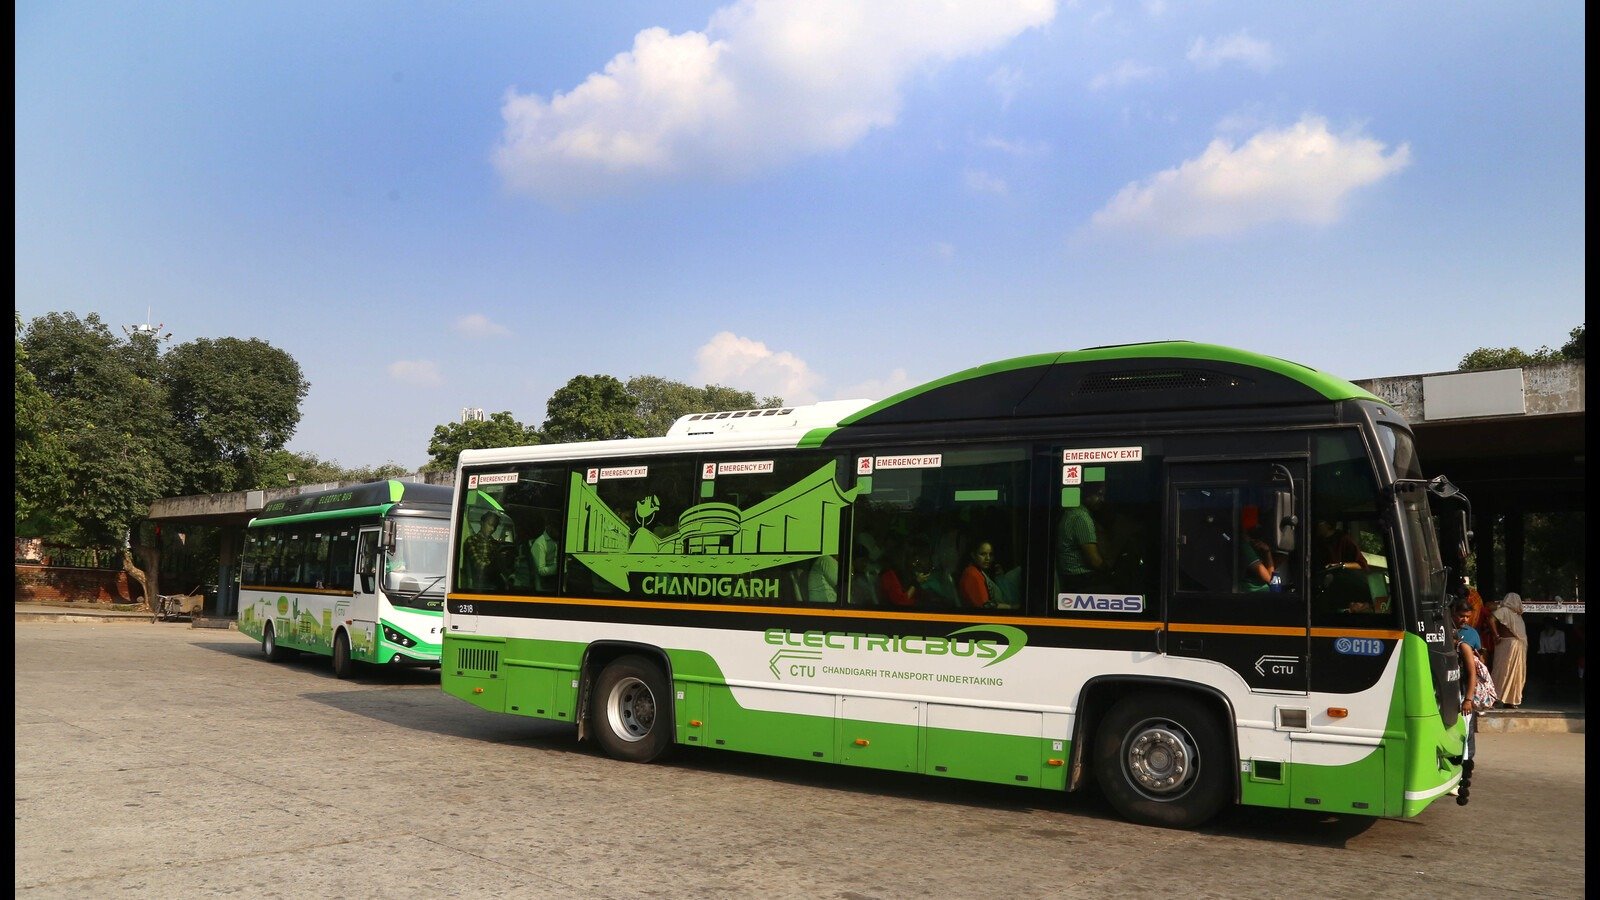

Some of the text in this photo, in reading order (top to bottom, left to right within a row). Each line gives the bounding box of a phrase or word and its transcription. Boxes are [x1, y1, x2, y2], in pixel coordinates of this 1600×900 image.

[1065, 449, 1140, 461] EMERGENCY EXIT
[719, 463, 772, 473] EMERGENCY EXIT
[876, 457, 939, 467] EMERGENCY EXIT
[480, 474, 517, 483] EMERGENCY EXIT
[601, 468, 646, 477] EMERGENCY EXIT
[641, 576, 780, 599] CHANDIGARH
[1061, 595, 1142, 611] eMaaS
[764, 628, 998, 659] ELECTRICBUS
[1352, 639, 1381, 655] CT13
[789, 664, 816, 678] CTU
[822, 666, 1004, 687] CHANDIGARH TRANSPORT UNDERTAKING
[1271, 665, 1294, 675] CTU
